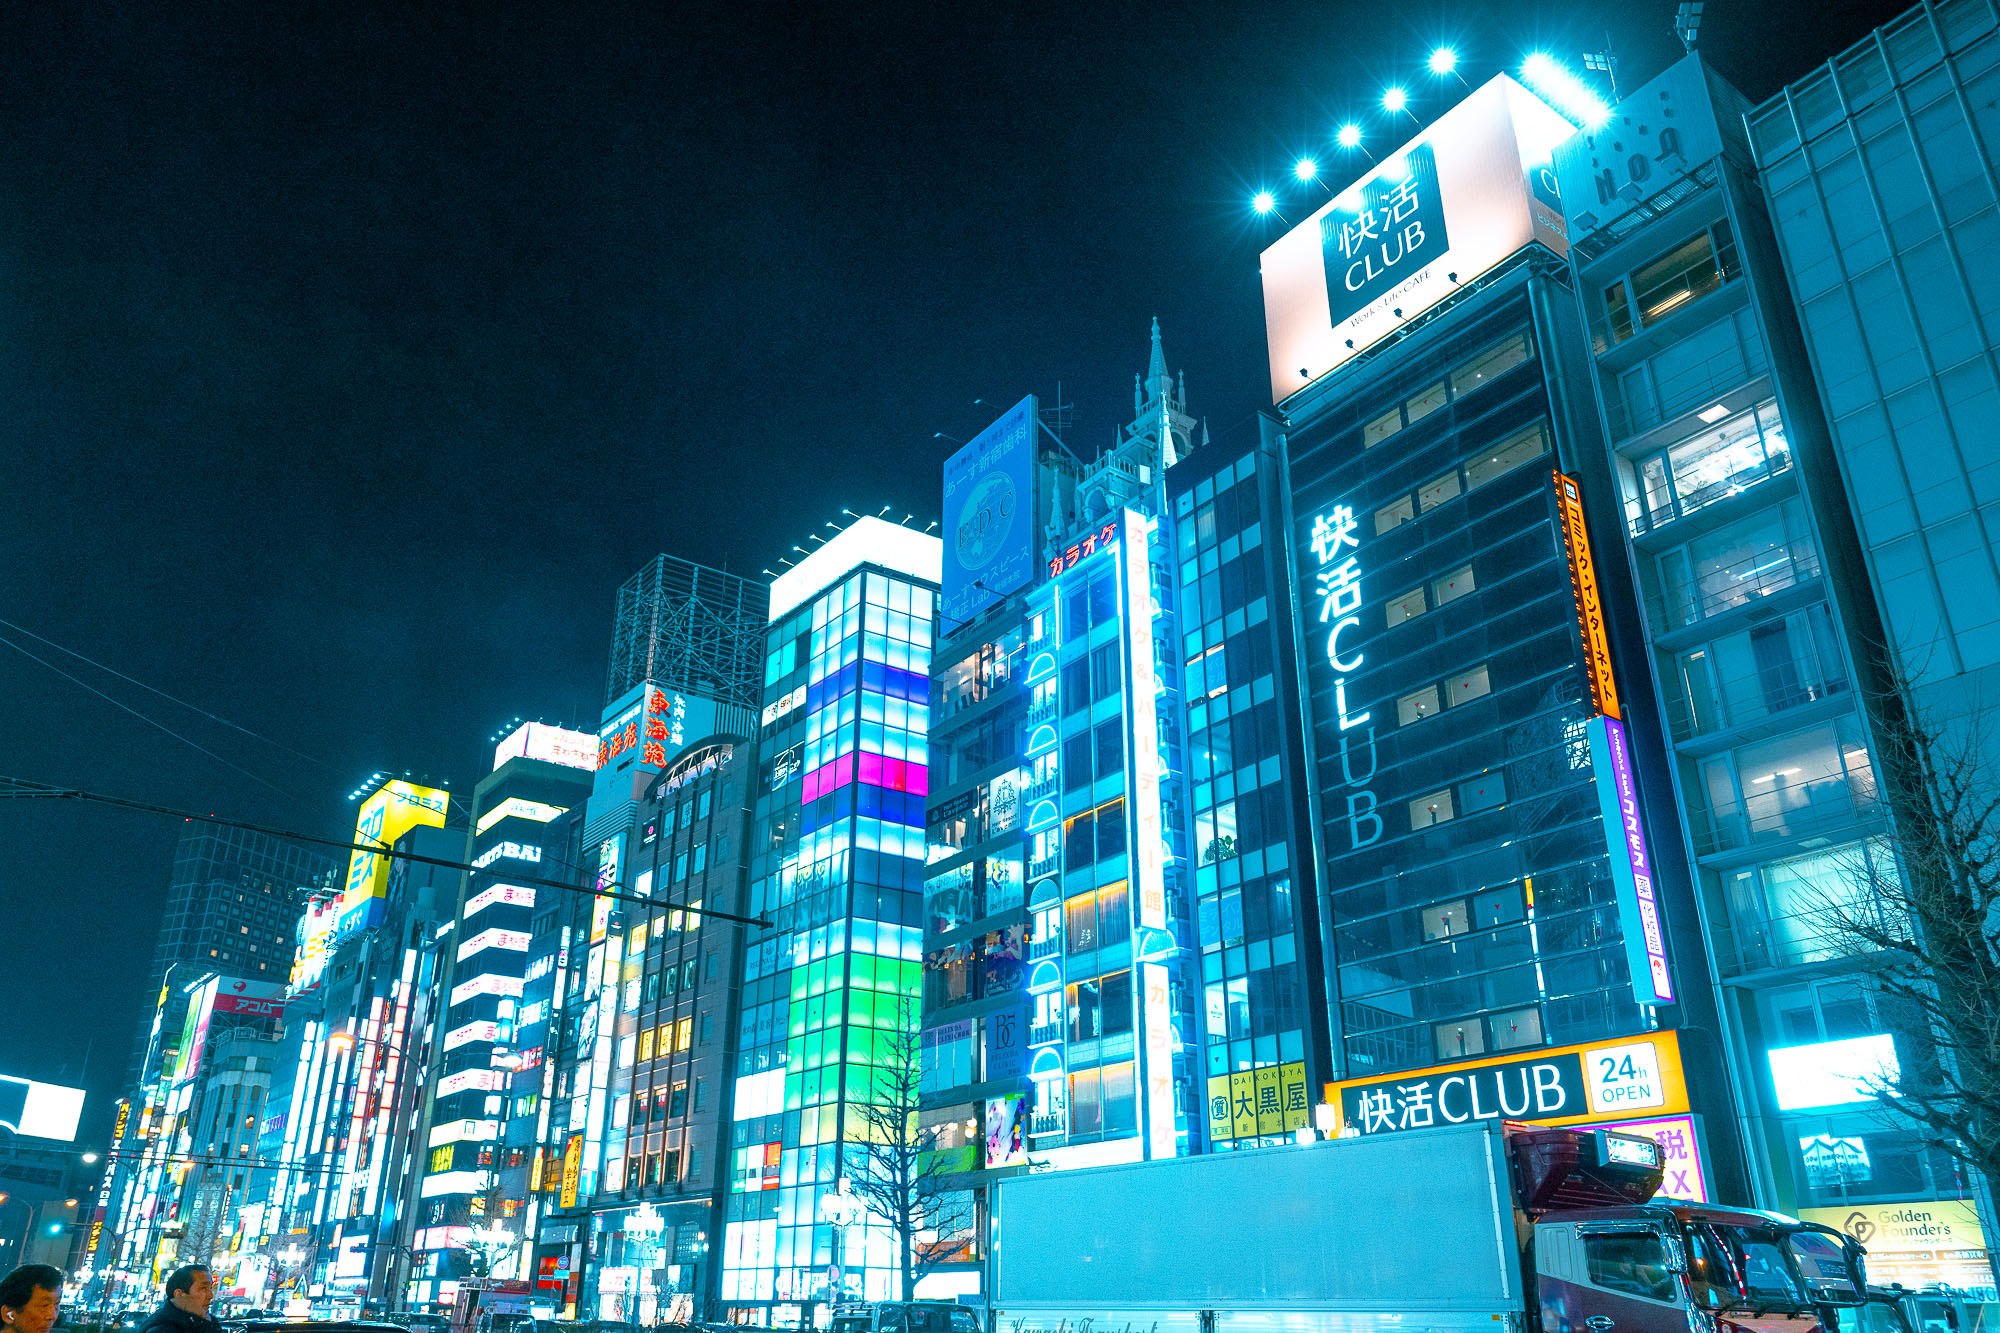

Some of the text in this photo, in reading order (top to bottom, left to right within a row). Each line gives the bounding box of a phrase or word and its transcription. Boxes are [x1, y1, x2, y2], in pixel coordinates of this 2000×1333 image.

[1339, 174, 1419, 259] 快活
[1345, 220, 1426, 292] CLUB
[1350, 307, 1375, 329] Work
[959, 489, 1014, 549] EDC
[1050, 523, 1117, 578] カラオケ
[971, 588, 990, 608] Lab
[1569, 506, 1613, 701] コミック・インターネット
[640, 688, 670, 768] 東海苑
[1623, 799, 1645, 869] コスモス
[1637, 877, 1651, 897] 薬
[1643, 903, 1661, 952] 化粧品
[235, 999, 273, 1014] アコム
[1234, 1068, 1302, 1085] DAIKOKUYA
[1600, 1054, 1648, 1083] 24h
[1235, 1082, 1307, 1119] 大黒屋
[1358, 1064, 1567, 1134] 快活CLUB
[1602, 1084, 1651, 1103] OPEN
[1879, 1209, 1932, 1224] Golden
[1881, 1220, 1951, 1238] Founder's
